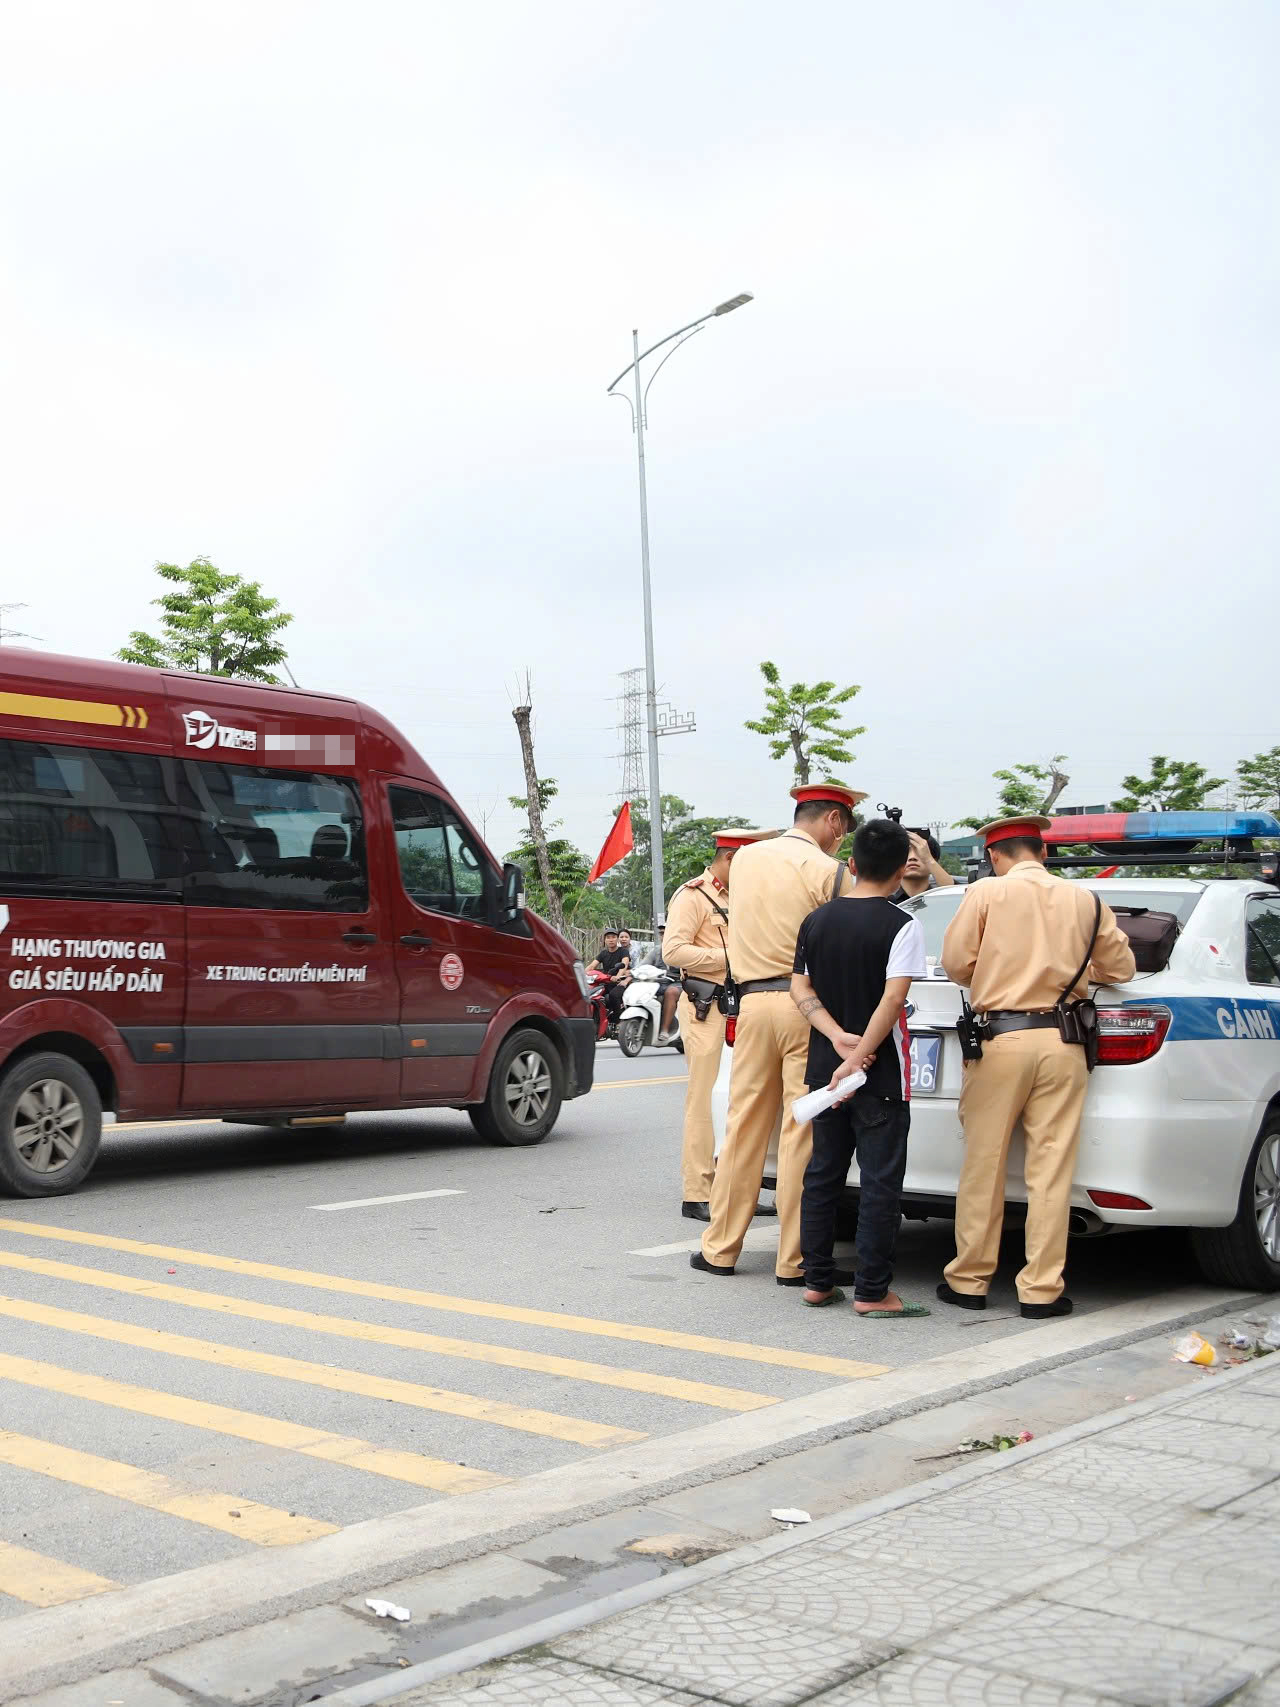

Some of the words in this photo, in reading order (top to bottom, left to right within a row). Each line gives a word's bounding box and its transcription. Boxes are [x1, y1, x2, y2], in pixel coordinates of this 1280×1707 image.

[10, 937, 62, 962] HẠNG
[63, 938, 136, 960] THƯƠNG
[137, 941, 167, 960] GIA
[8, 965, 42, 990] GIÁ
[44, 966, 87, 991] SIÊU
[87, 964, 126, 992] HẤP
[125, 967, 164, 993] DẪN
[205, 965, 225, 980] XE
[224, 965, 267, 982] TRUNG
[267, 961, 317, 982] CHUYỂN
[316, 963, 346, 982] MIỄN
[346, 964, 368, 982] PHÍ
[1216, 998, 1277, 1040] CẢNH
